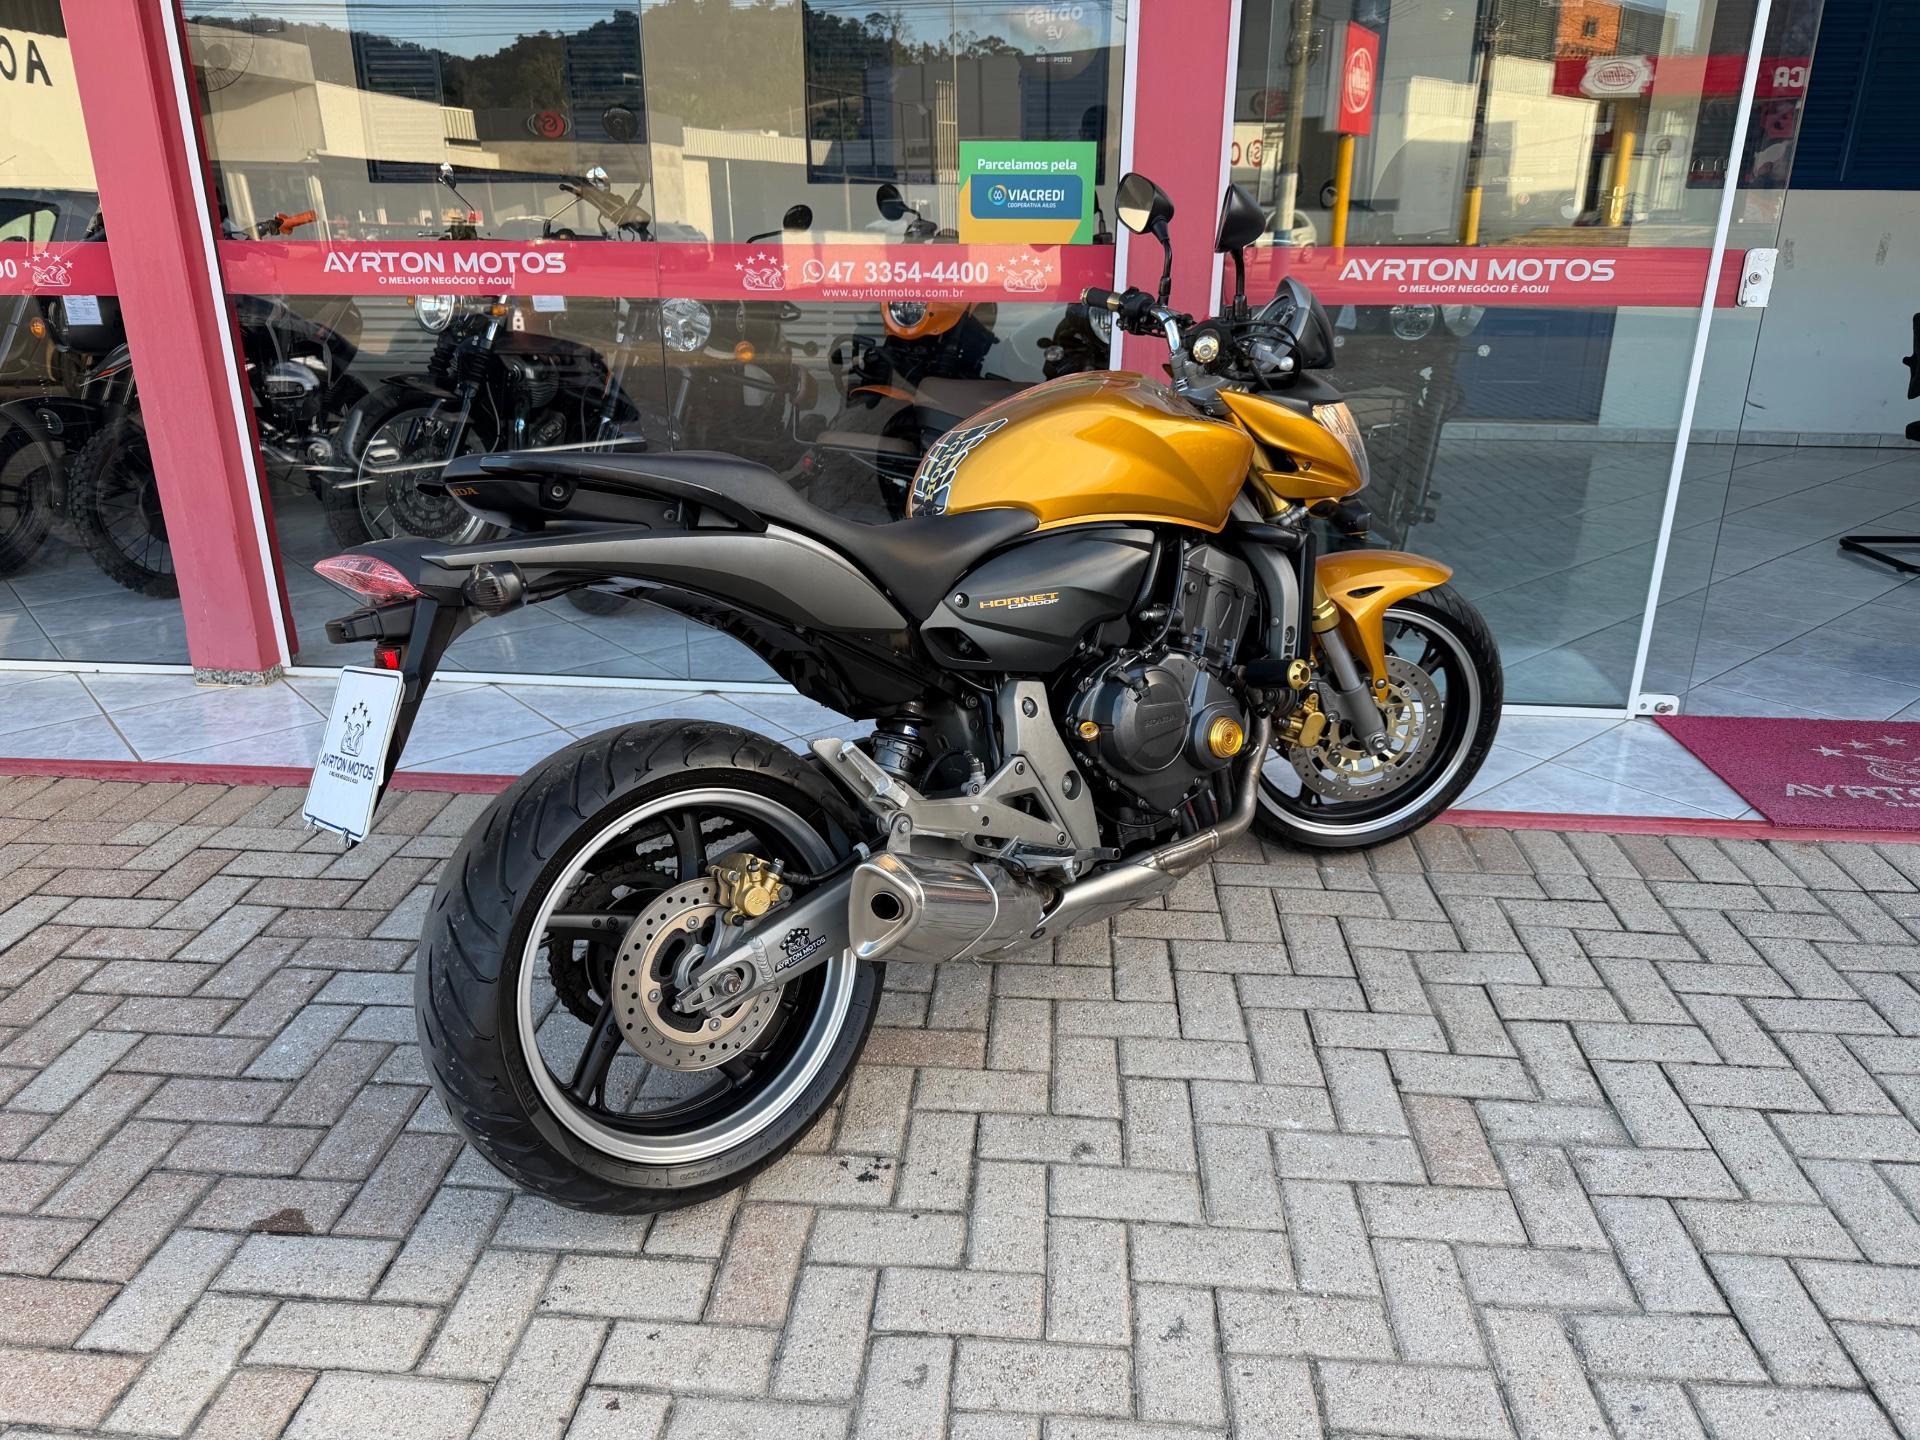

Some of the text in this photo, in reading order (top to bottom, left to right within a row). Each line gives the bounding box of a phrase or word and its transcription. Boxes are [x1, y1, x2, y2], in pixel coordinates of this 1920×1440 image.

[977, 158, 1077, 172] Parcelamos pela
[1008, 189, 1065, 202] VIACREDI
[323, 251, 567, 274] AYRTON MOTOS
[1338, 258, 1617, 281] AYRTON MOTOS
[378, 274, 512, 286] O MELHOR NEGÓCIO É AQUI
[827, 261, 989, 284] 47 3354-4400
[822, 287, 965, 299] www.ayrtonmotos.com.br
[1398, 283, 1550, 293] O MELHOR NEGÓCIO É AQUI
[979, 591, 1059, 609] HORNET
[321, 753, 347, 772] AYRTON
[347, 760, 374, 780] MOTOS
[777, 951, 802, 970] AYRTON
[802, 937, 825, 954] MOTOS
